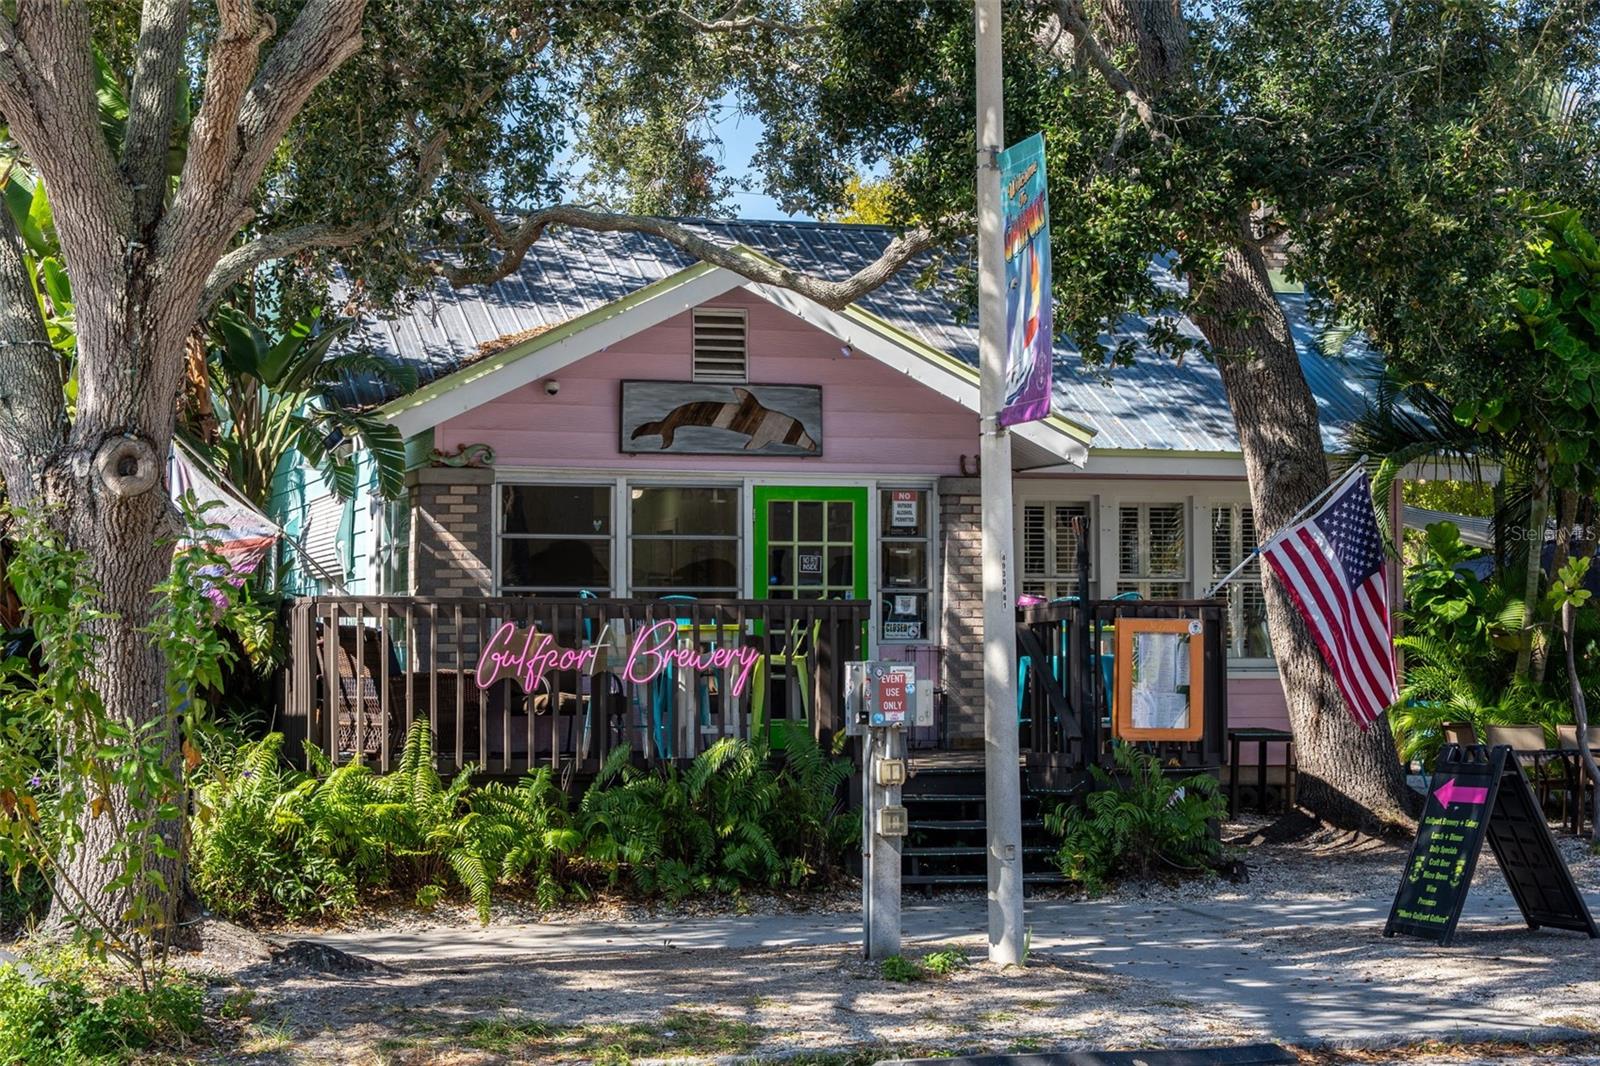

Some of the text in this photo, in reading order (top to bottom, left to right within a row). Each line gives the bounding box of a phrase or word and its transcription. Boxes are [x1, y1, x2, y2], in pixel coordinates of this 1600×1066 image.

[898, 492, 911, 500] NO
[885, 623, 908, 633] CLOSED
[476, 619, 760, 697] Gulfport Brewery
[881, 674, 904, 683] EVENT
[885, 688, 900, 697] USE
[883, 701, 903, 710] ONLY
